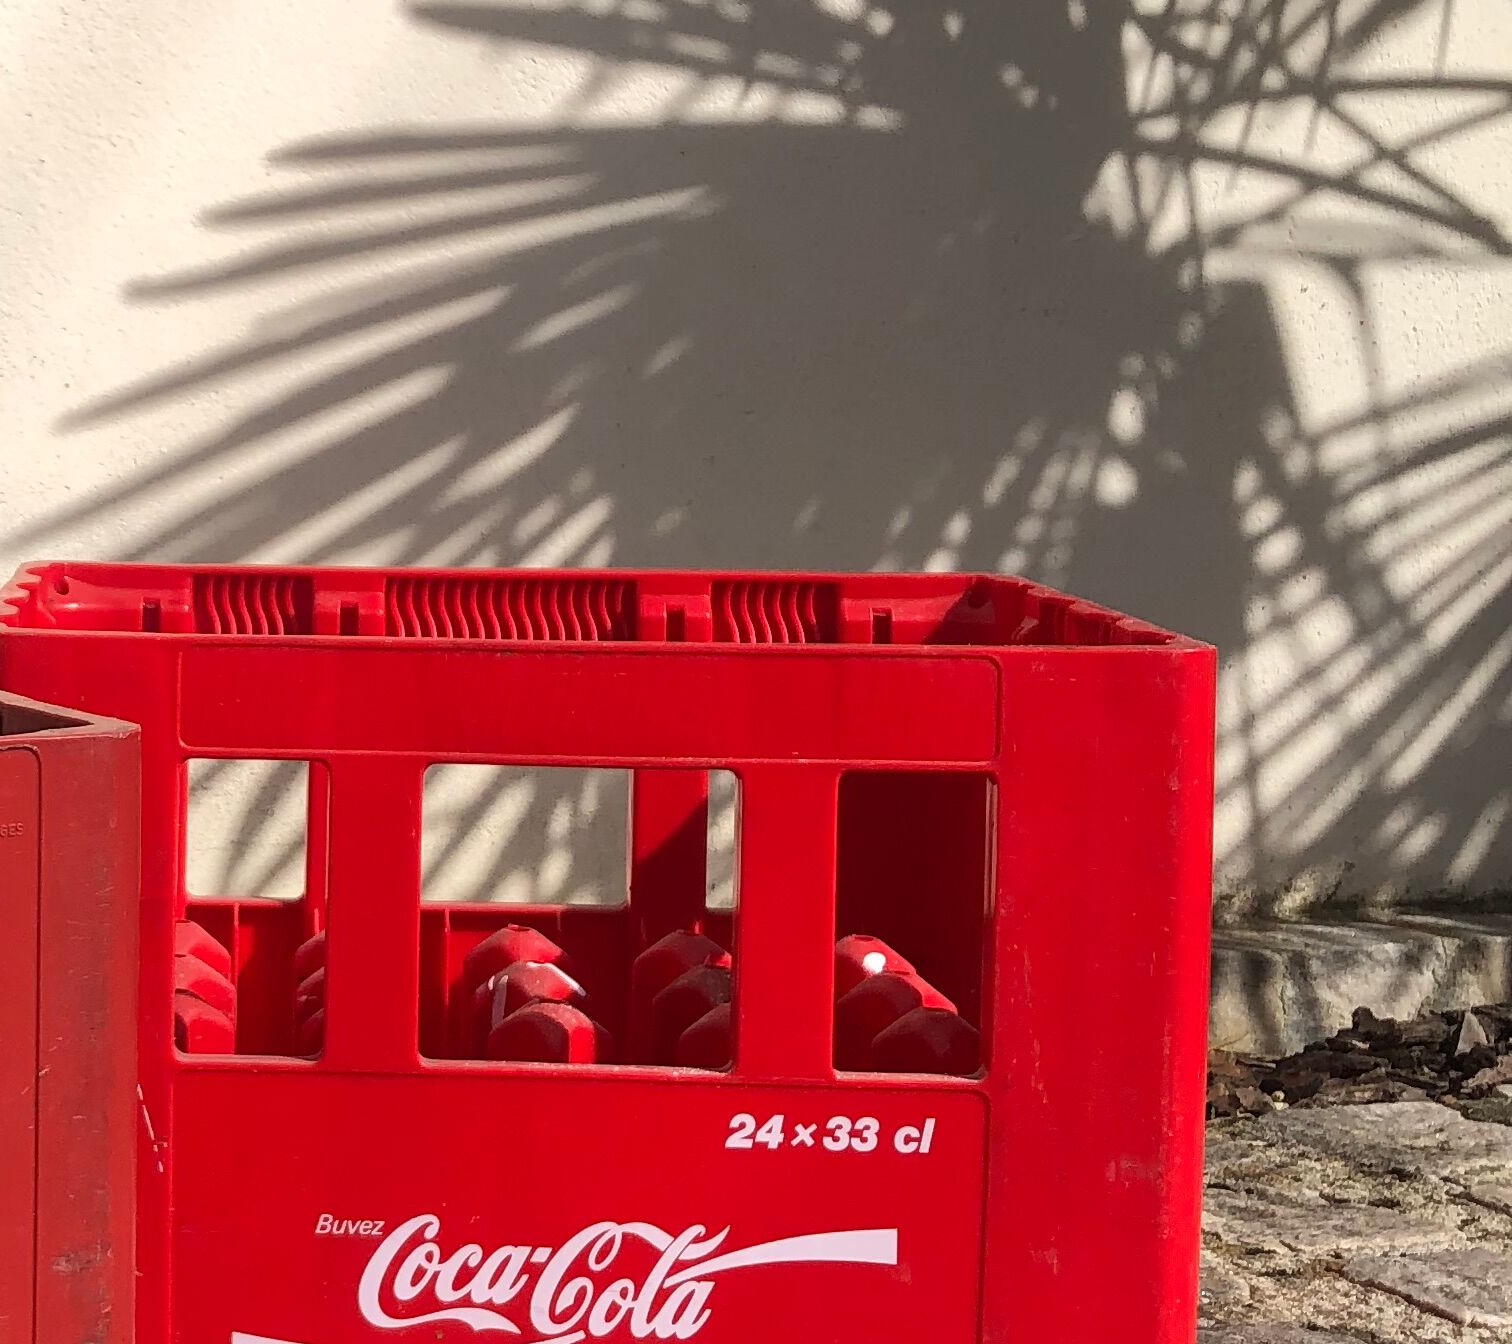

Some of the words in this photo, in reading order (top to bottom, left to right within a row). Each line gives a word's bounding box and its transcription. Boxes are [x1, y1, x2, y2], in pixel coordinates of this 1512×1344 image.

[894, 1117, 935, 1154] cl
[314, 1213, 385, 1236] Buvez
[358, 1213, 730, 1340] Coca-Cola
